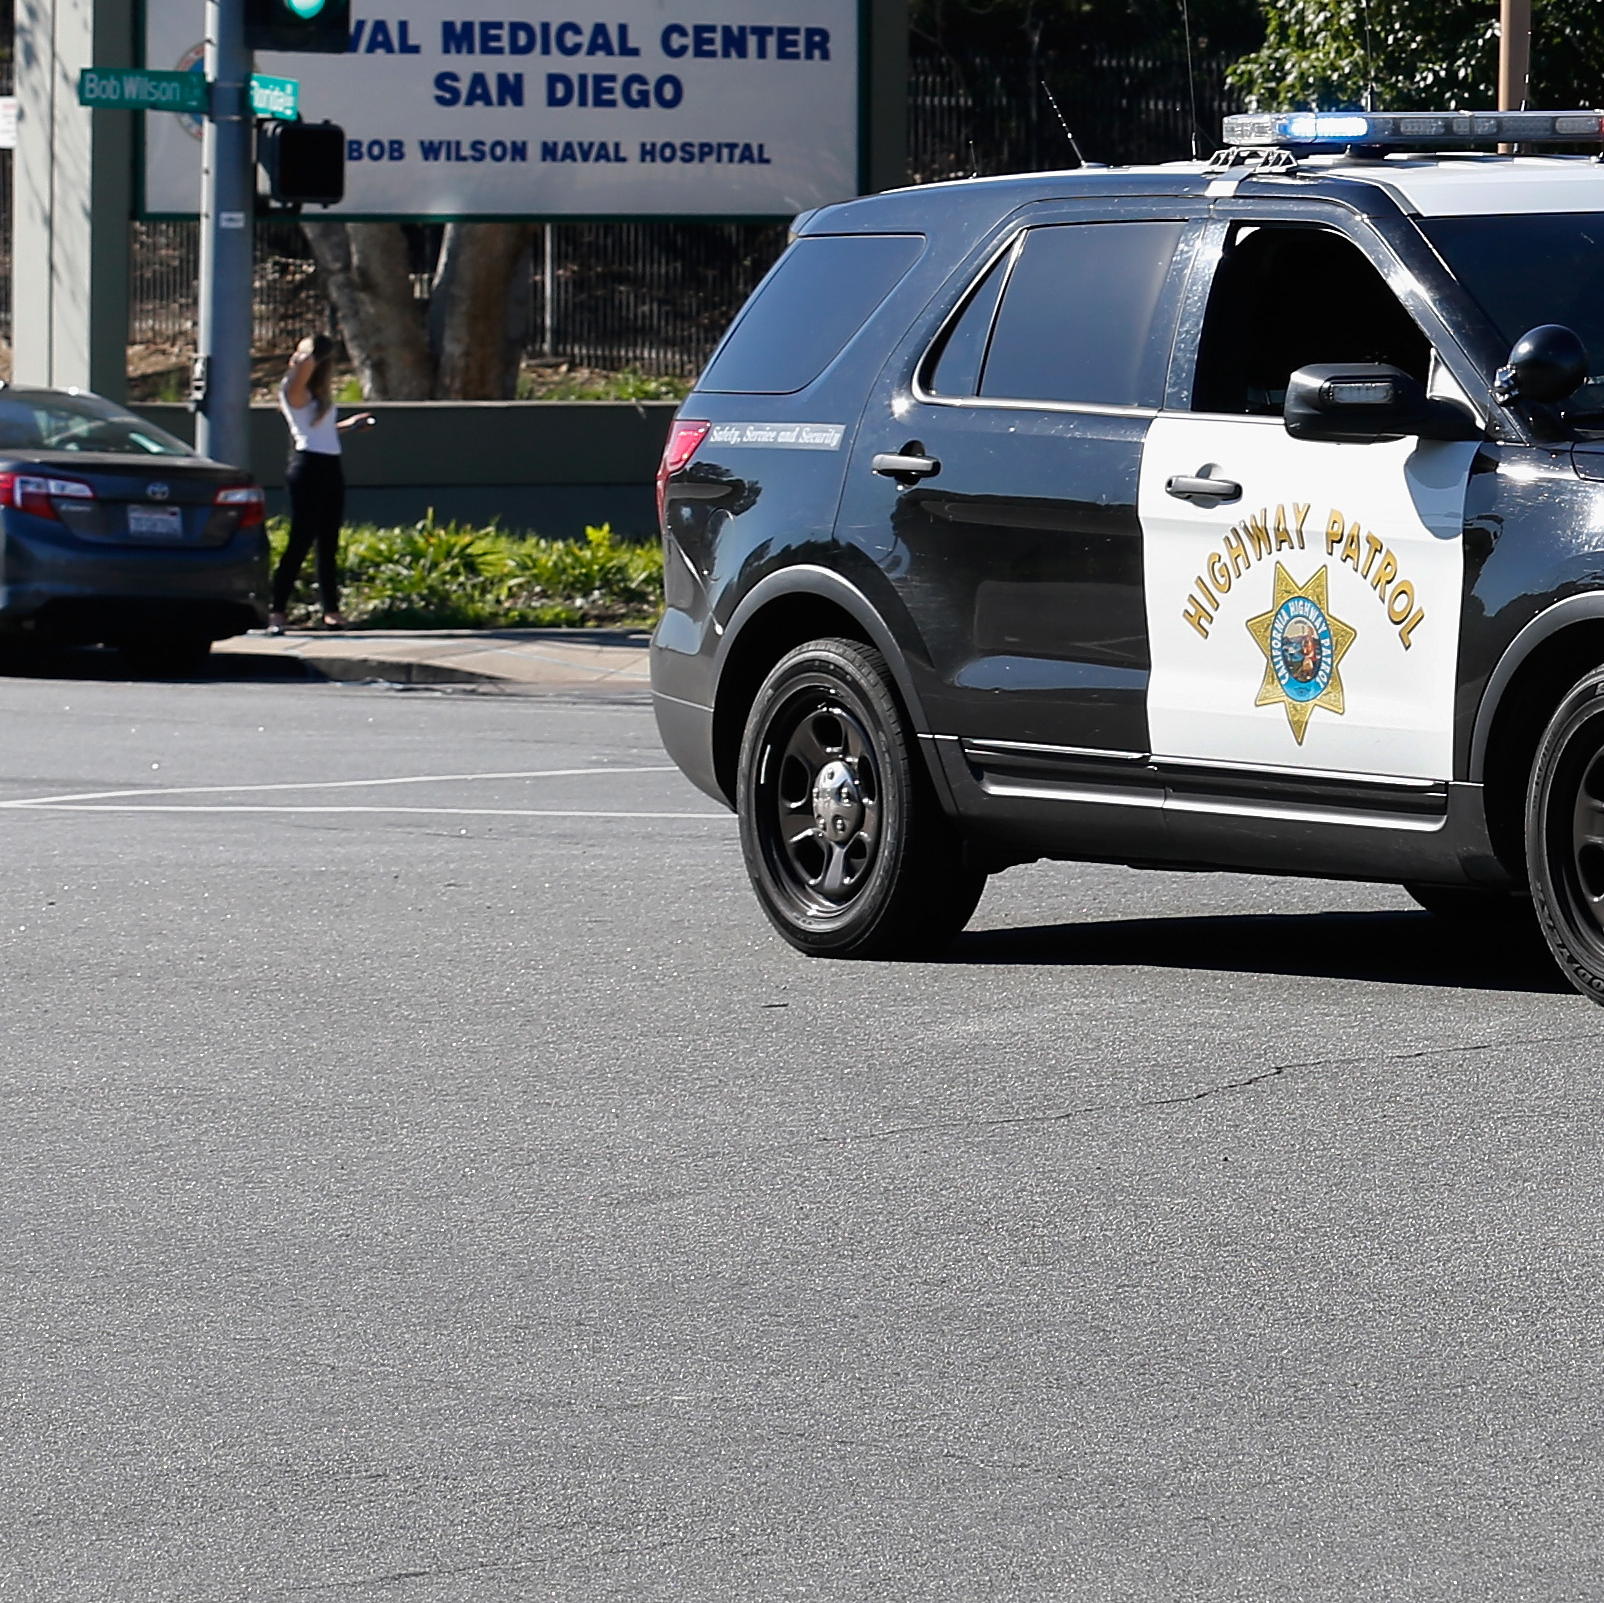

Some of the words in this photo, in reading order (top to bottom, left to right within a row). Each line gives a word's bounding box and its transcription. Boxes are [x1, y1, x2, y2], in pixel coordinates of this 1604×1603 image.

[349, 18, 422, 55] VAL
[441, 20, 641, 57] MEDICAL
[660, 22, 832, 62] CENTER
[84, 73, 119, 99] Bob
[123, 74, 181, 102] Wilson
[432, 70, 525, 108] SAN
[545, 72, 685, 110] DIEGO
[346, 138, 406, 162] BOB
[418, 139, 529, 163] WILSON
[539, 140, 628, 164] NAVAL
[638, 141, 772, 166] HOSPITAL
[709, 425, 741, 445] Safety,
[743, 425, 777, 444] Service
[777, 427, 800, 443] and
[799, 427, 842, 447] Security
[1182, 502, 1311, 640] HIGHWAY
[1324, 508, 1425, 652] PATROL
[1271, 608, 1290, 686] CALIFORNIA
[1288, 599, 1327, 635] HIGHWAY
[1315, 637, 1333, 690] PATROL
